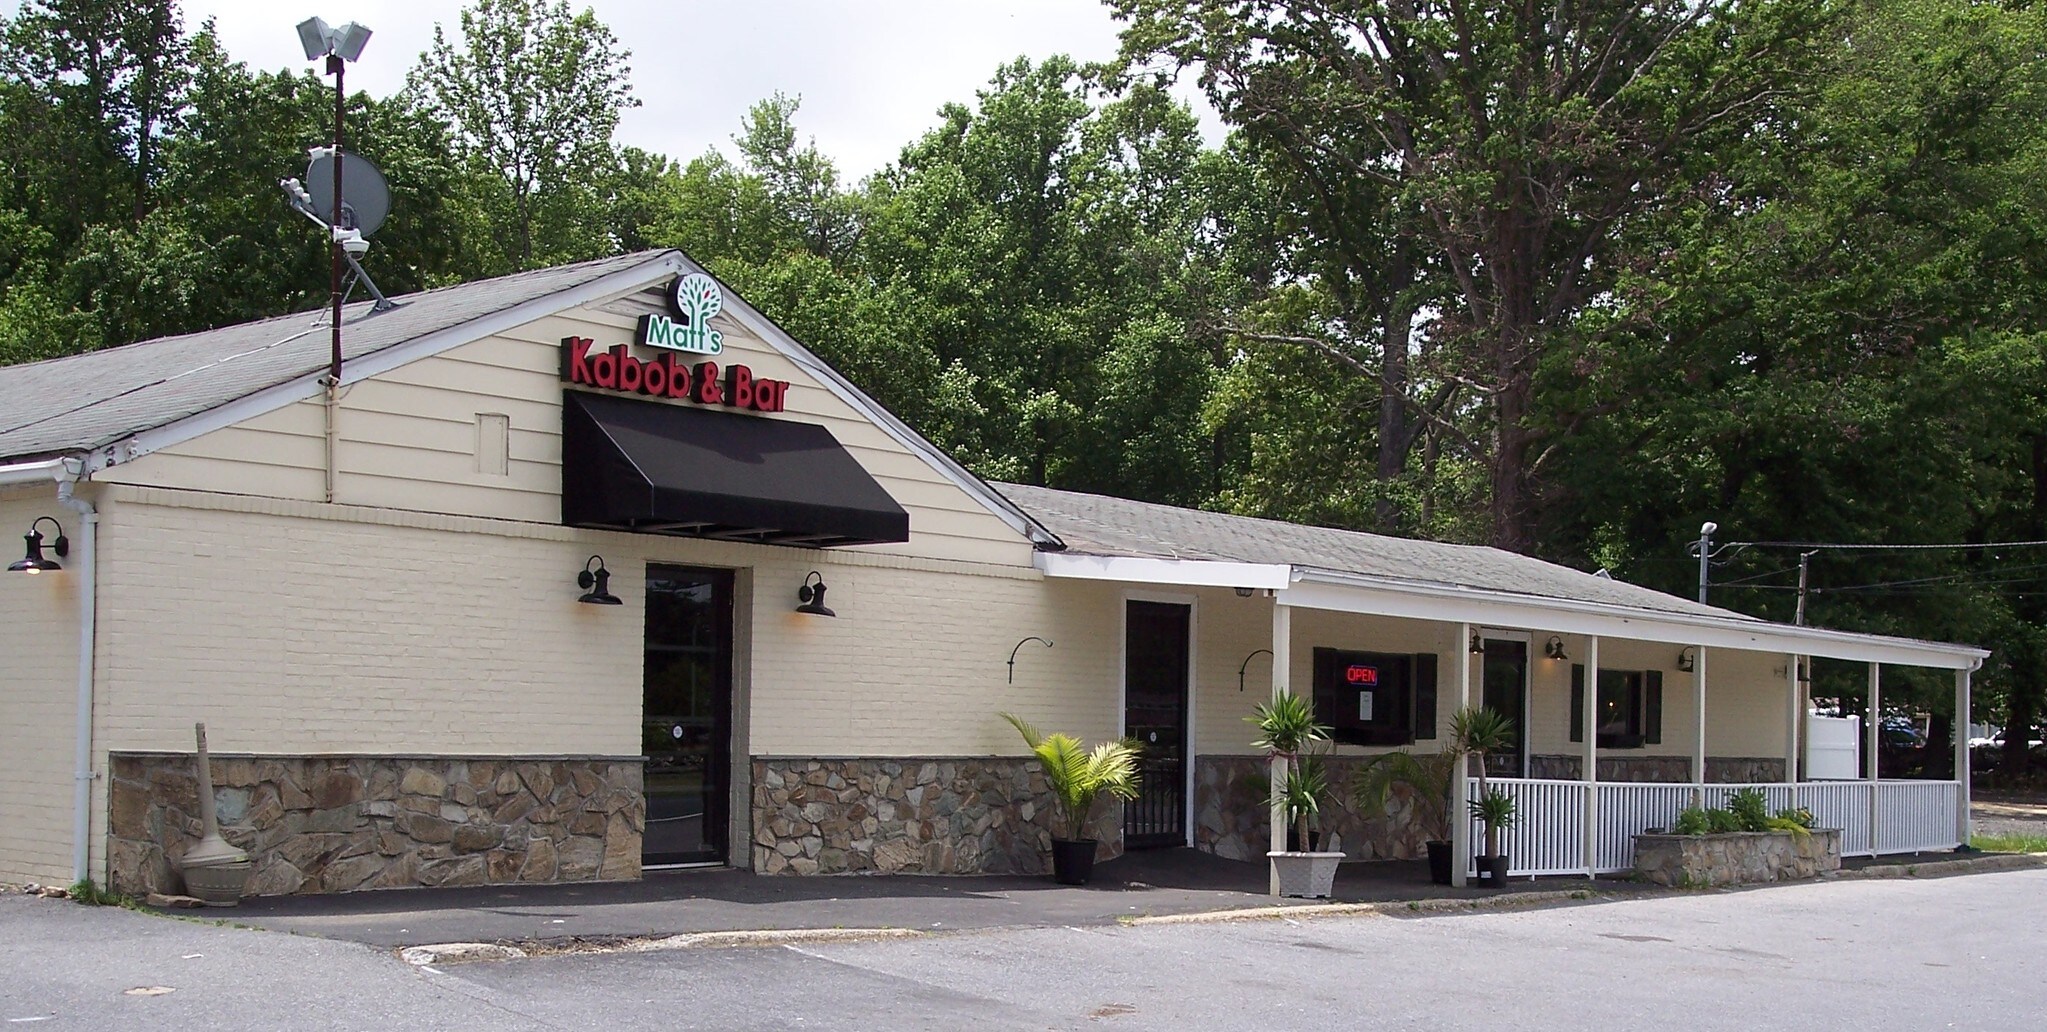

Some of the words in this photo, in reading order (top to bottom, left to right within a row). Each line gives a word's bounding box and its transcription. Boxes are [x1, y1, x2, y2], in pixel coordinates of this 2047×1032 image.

[648, 314, 721, 353] Matt's
[569, 336, 691, 399] Kabob
[700, 361, 723, 404] &
[734, 364, 790, 413] Bar
[1347, 667, 1376, 682] OPEN
